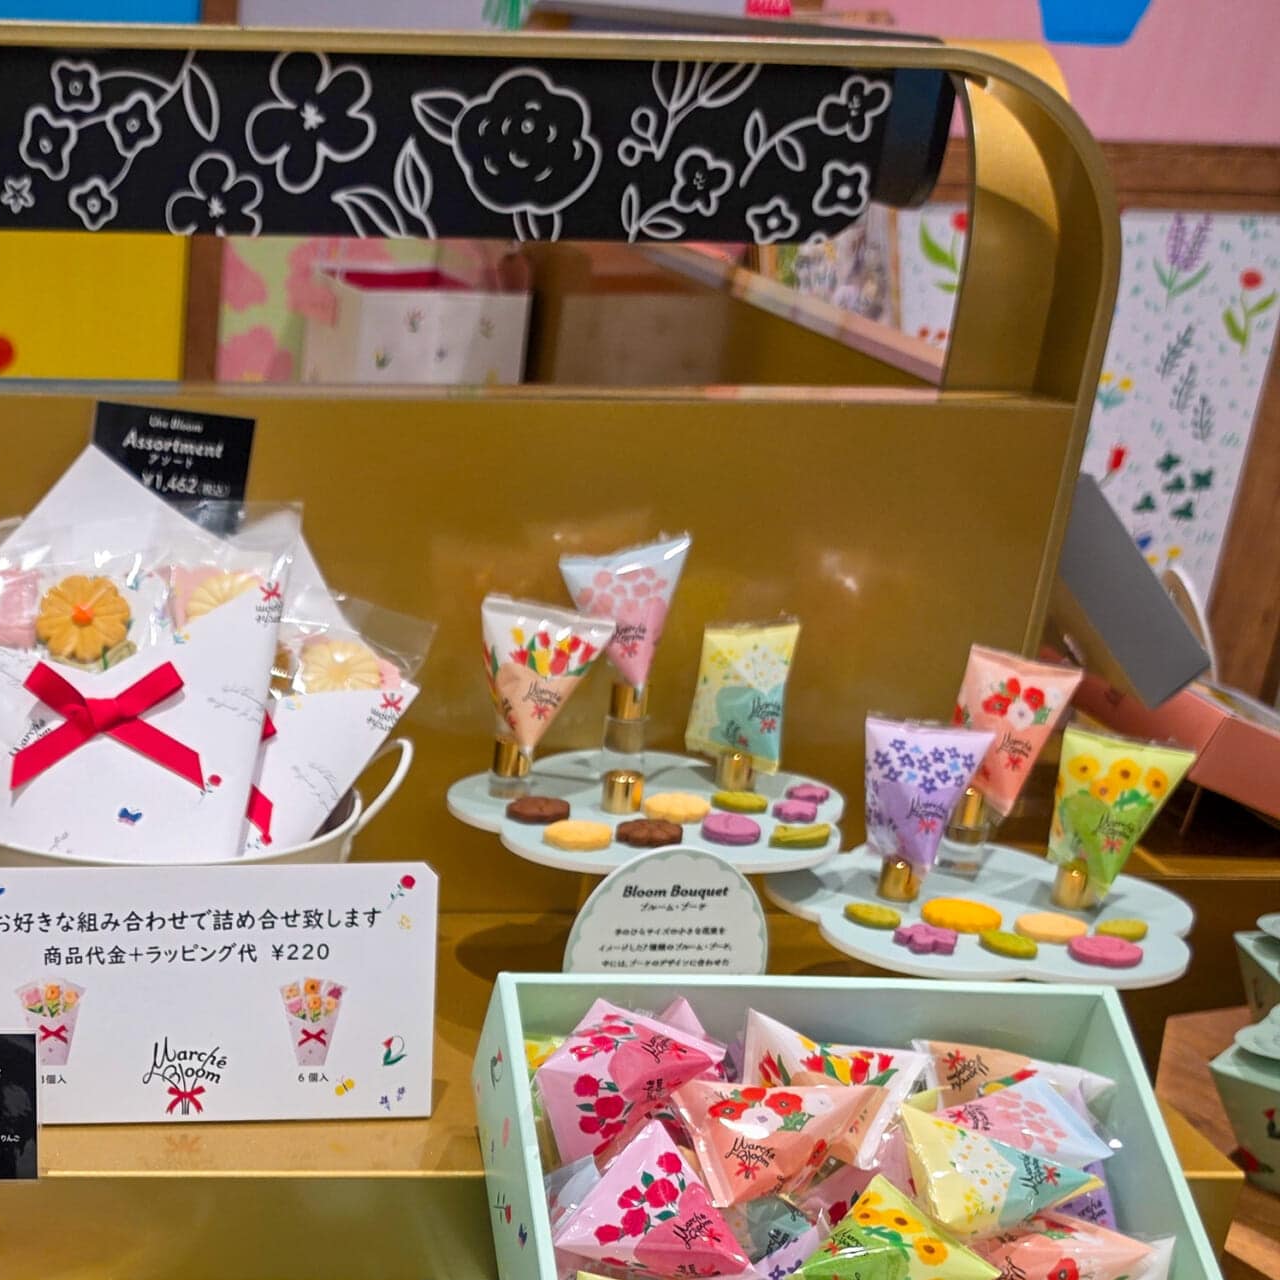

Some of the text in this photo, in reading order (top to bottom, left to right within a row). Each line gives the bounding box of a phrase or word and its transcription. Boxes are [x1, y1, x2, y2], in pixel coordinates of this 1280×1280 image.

[122, 427, 224, 459] Assortment
[622, 884, 729, 901] Bloom Bouquet
[271, 943, 331, 962] ¥220
[142, 1035, 228, 1085] Marché
[161, 1062, 223, 1090] Bloom
